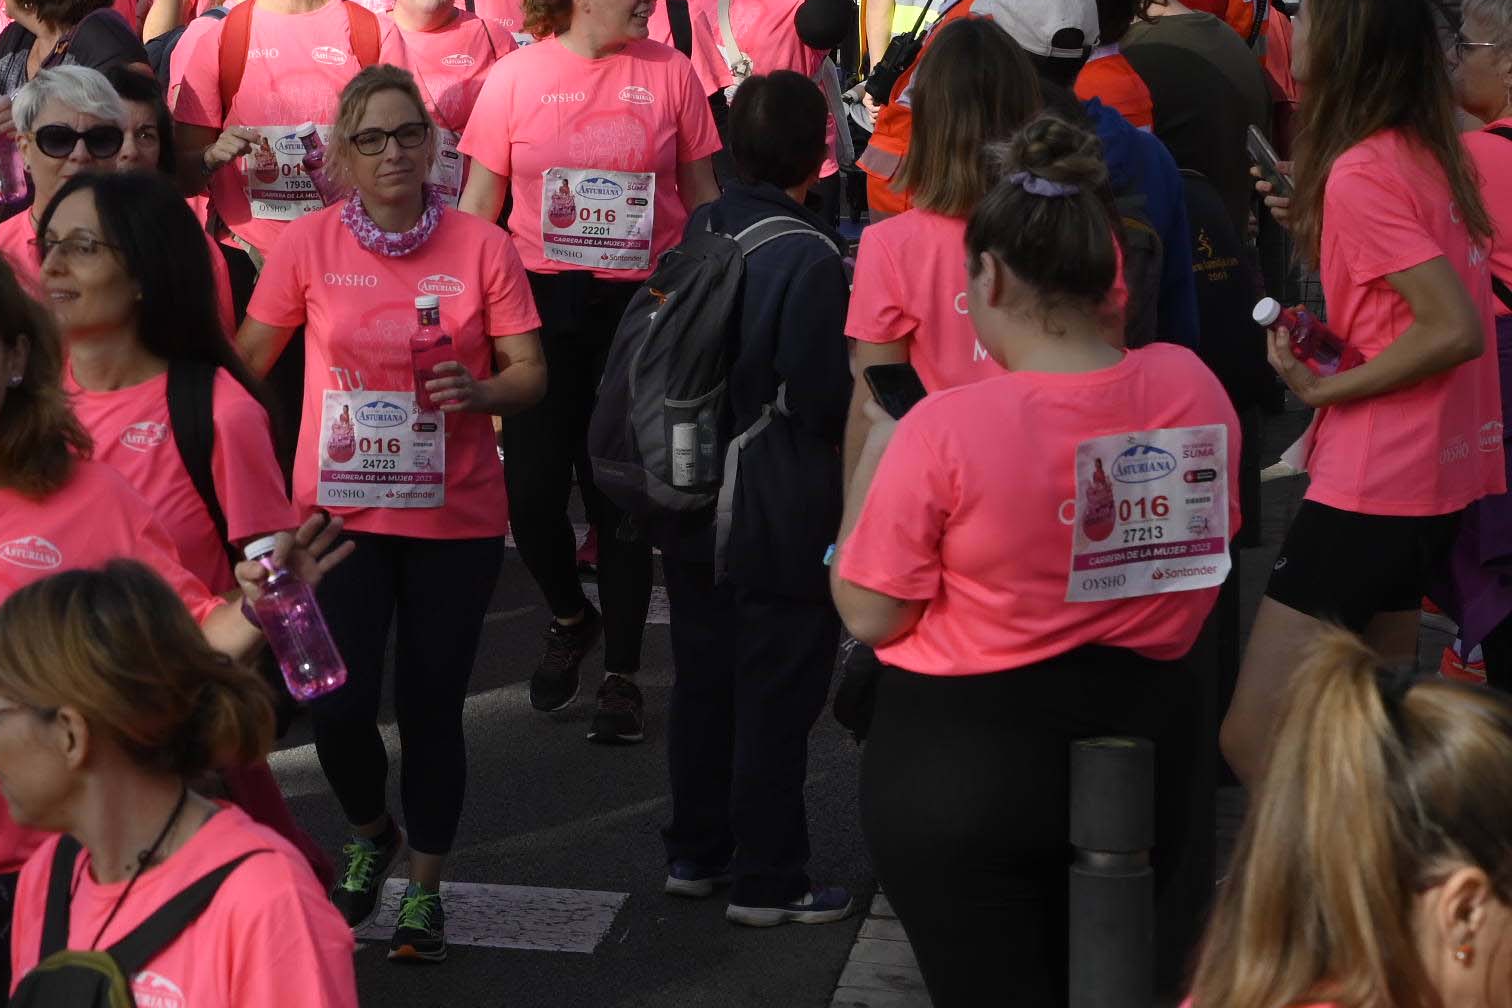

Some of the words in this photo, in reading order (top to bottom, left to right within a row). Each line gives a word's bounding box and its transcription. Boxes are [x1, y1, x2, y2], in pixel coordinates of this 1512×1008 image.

[541, 92, 586, 104] OYSHO
[285, 180, 312, 189] 17936
[578, 184, 620, 196] ASTURIANA
[579, 208, 617, 223] 016
[582, 226, 610, 235] 22201
[553, 237, 583, 245] CARRERA
[551, 248, 583, 259] OYSHO
[325, 272, 378, 288] OYSHO
[420, 282, 464, 293] ASTURIANA
[330, 366, 366, 392] TU
[358, 411, 403, 422] ASTURIANA
[359, 437, 401, 454] 016
[362, 459, 396, 470] 24723
[1115, 459, 1171, 478] ASTURIANA
[1182, 449, 1215, 459] SUMA
[331, 473, 364, 481] CARRERA
[365, 473, 375, 481] DE
[328, 489, 365, 499] OYSHO
[395, 490, 435, 499] Santander
[1119, 495, 1170, 522] 016
[1123, 525, 1163, 543] 27213
[1, 545, 56, 566] ASTURIANA
[1089, 551, 1125, 566] CARRERA
[1126, 549, 1139, 559] DE
[1140, 548, 1152, 558] LA
[1153, 545, 1186, 556] MUJER
[1082, 573, 1126, 592] OYSHO
[1164, 564, 1217, 580] Santander
